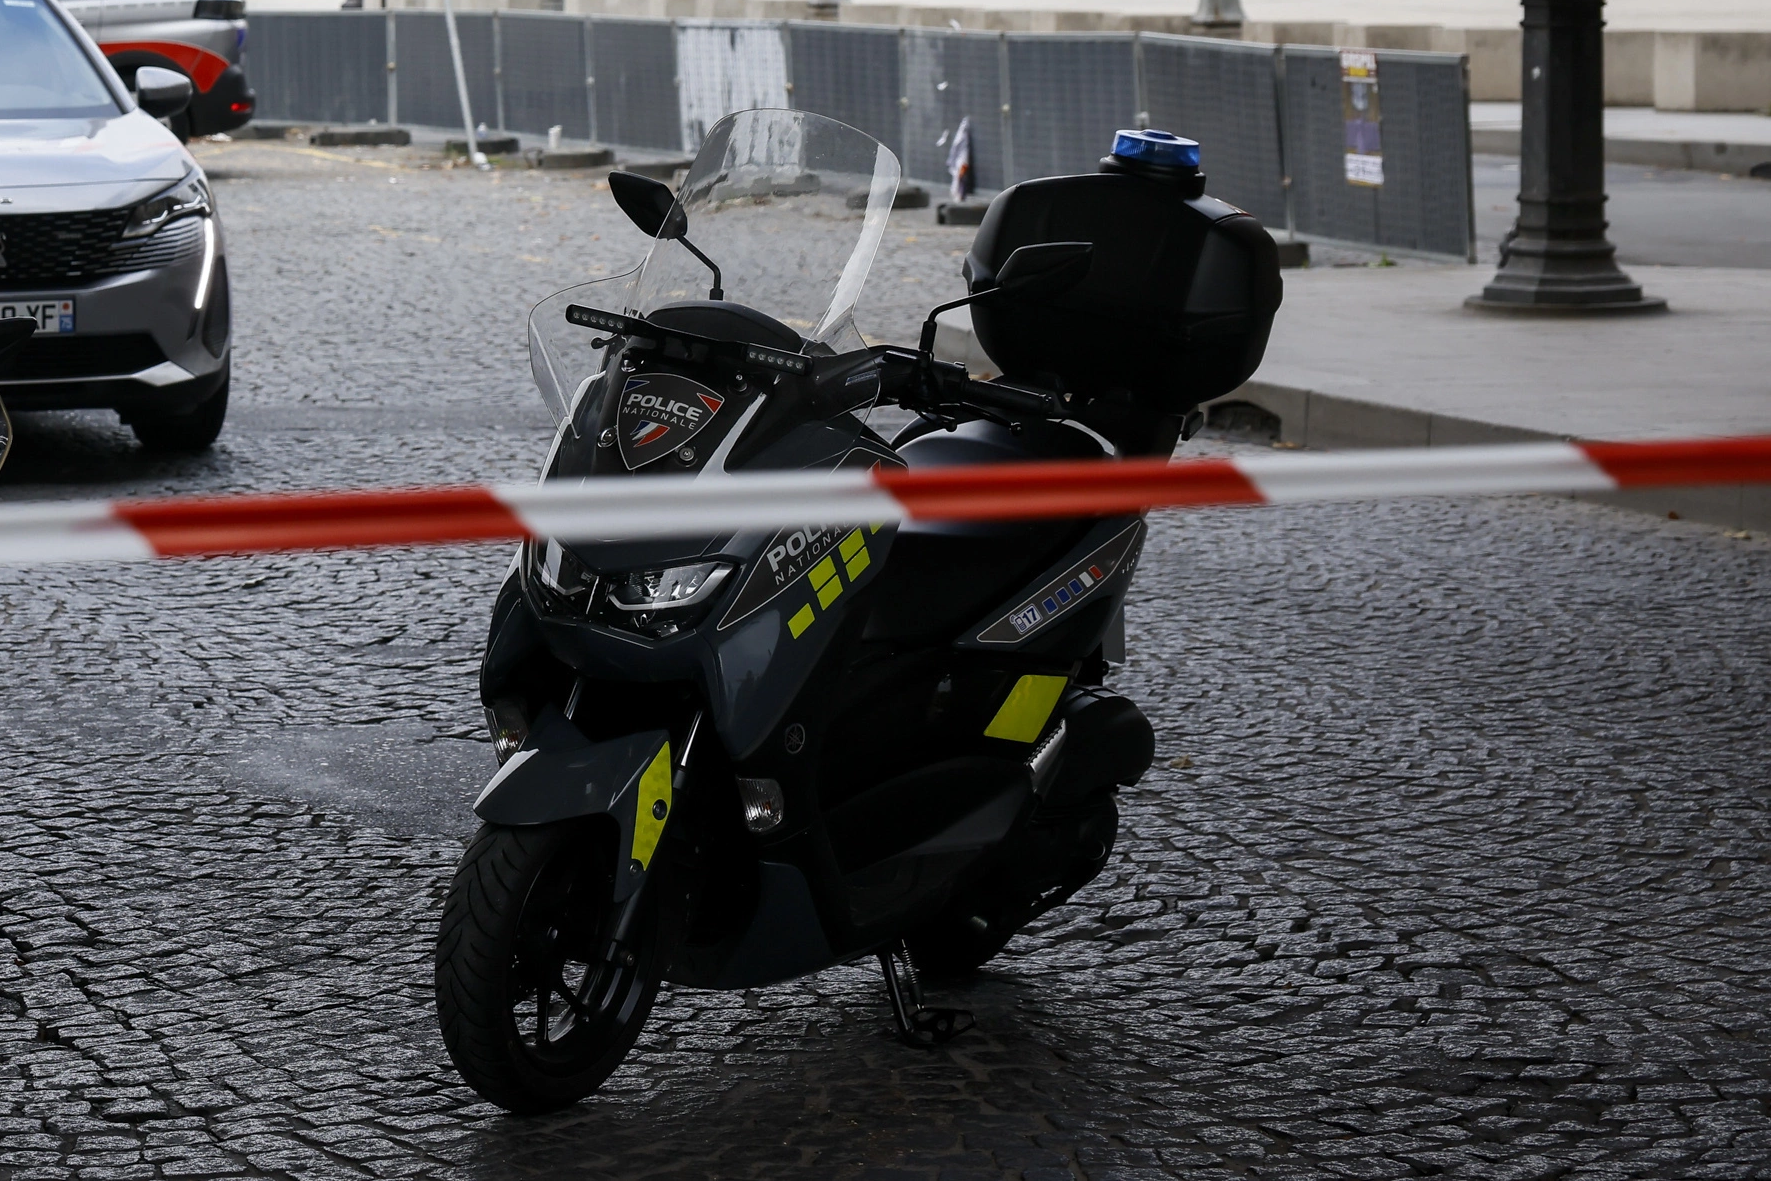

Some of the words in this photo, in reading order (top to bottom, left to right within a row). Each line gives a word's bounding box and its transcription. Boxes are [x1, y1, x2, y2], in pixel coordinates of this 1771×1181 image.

[622, 406, 697, 431] NATIONALE
[626, 393, 703, 422] POLICE
[1021, 607, 1037, 625] 17
